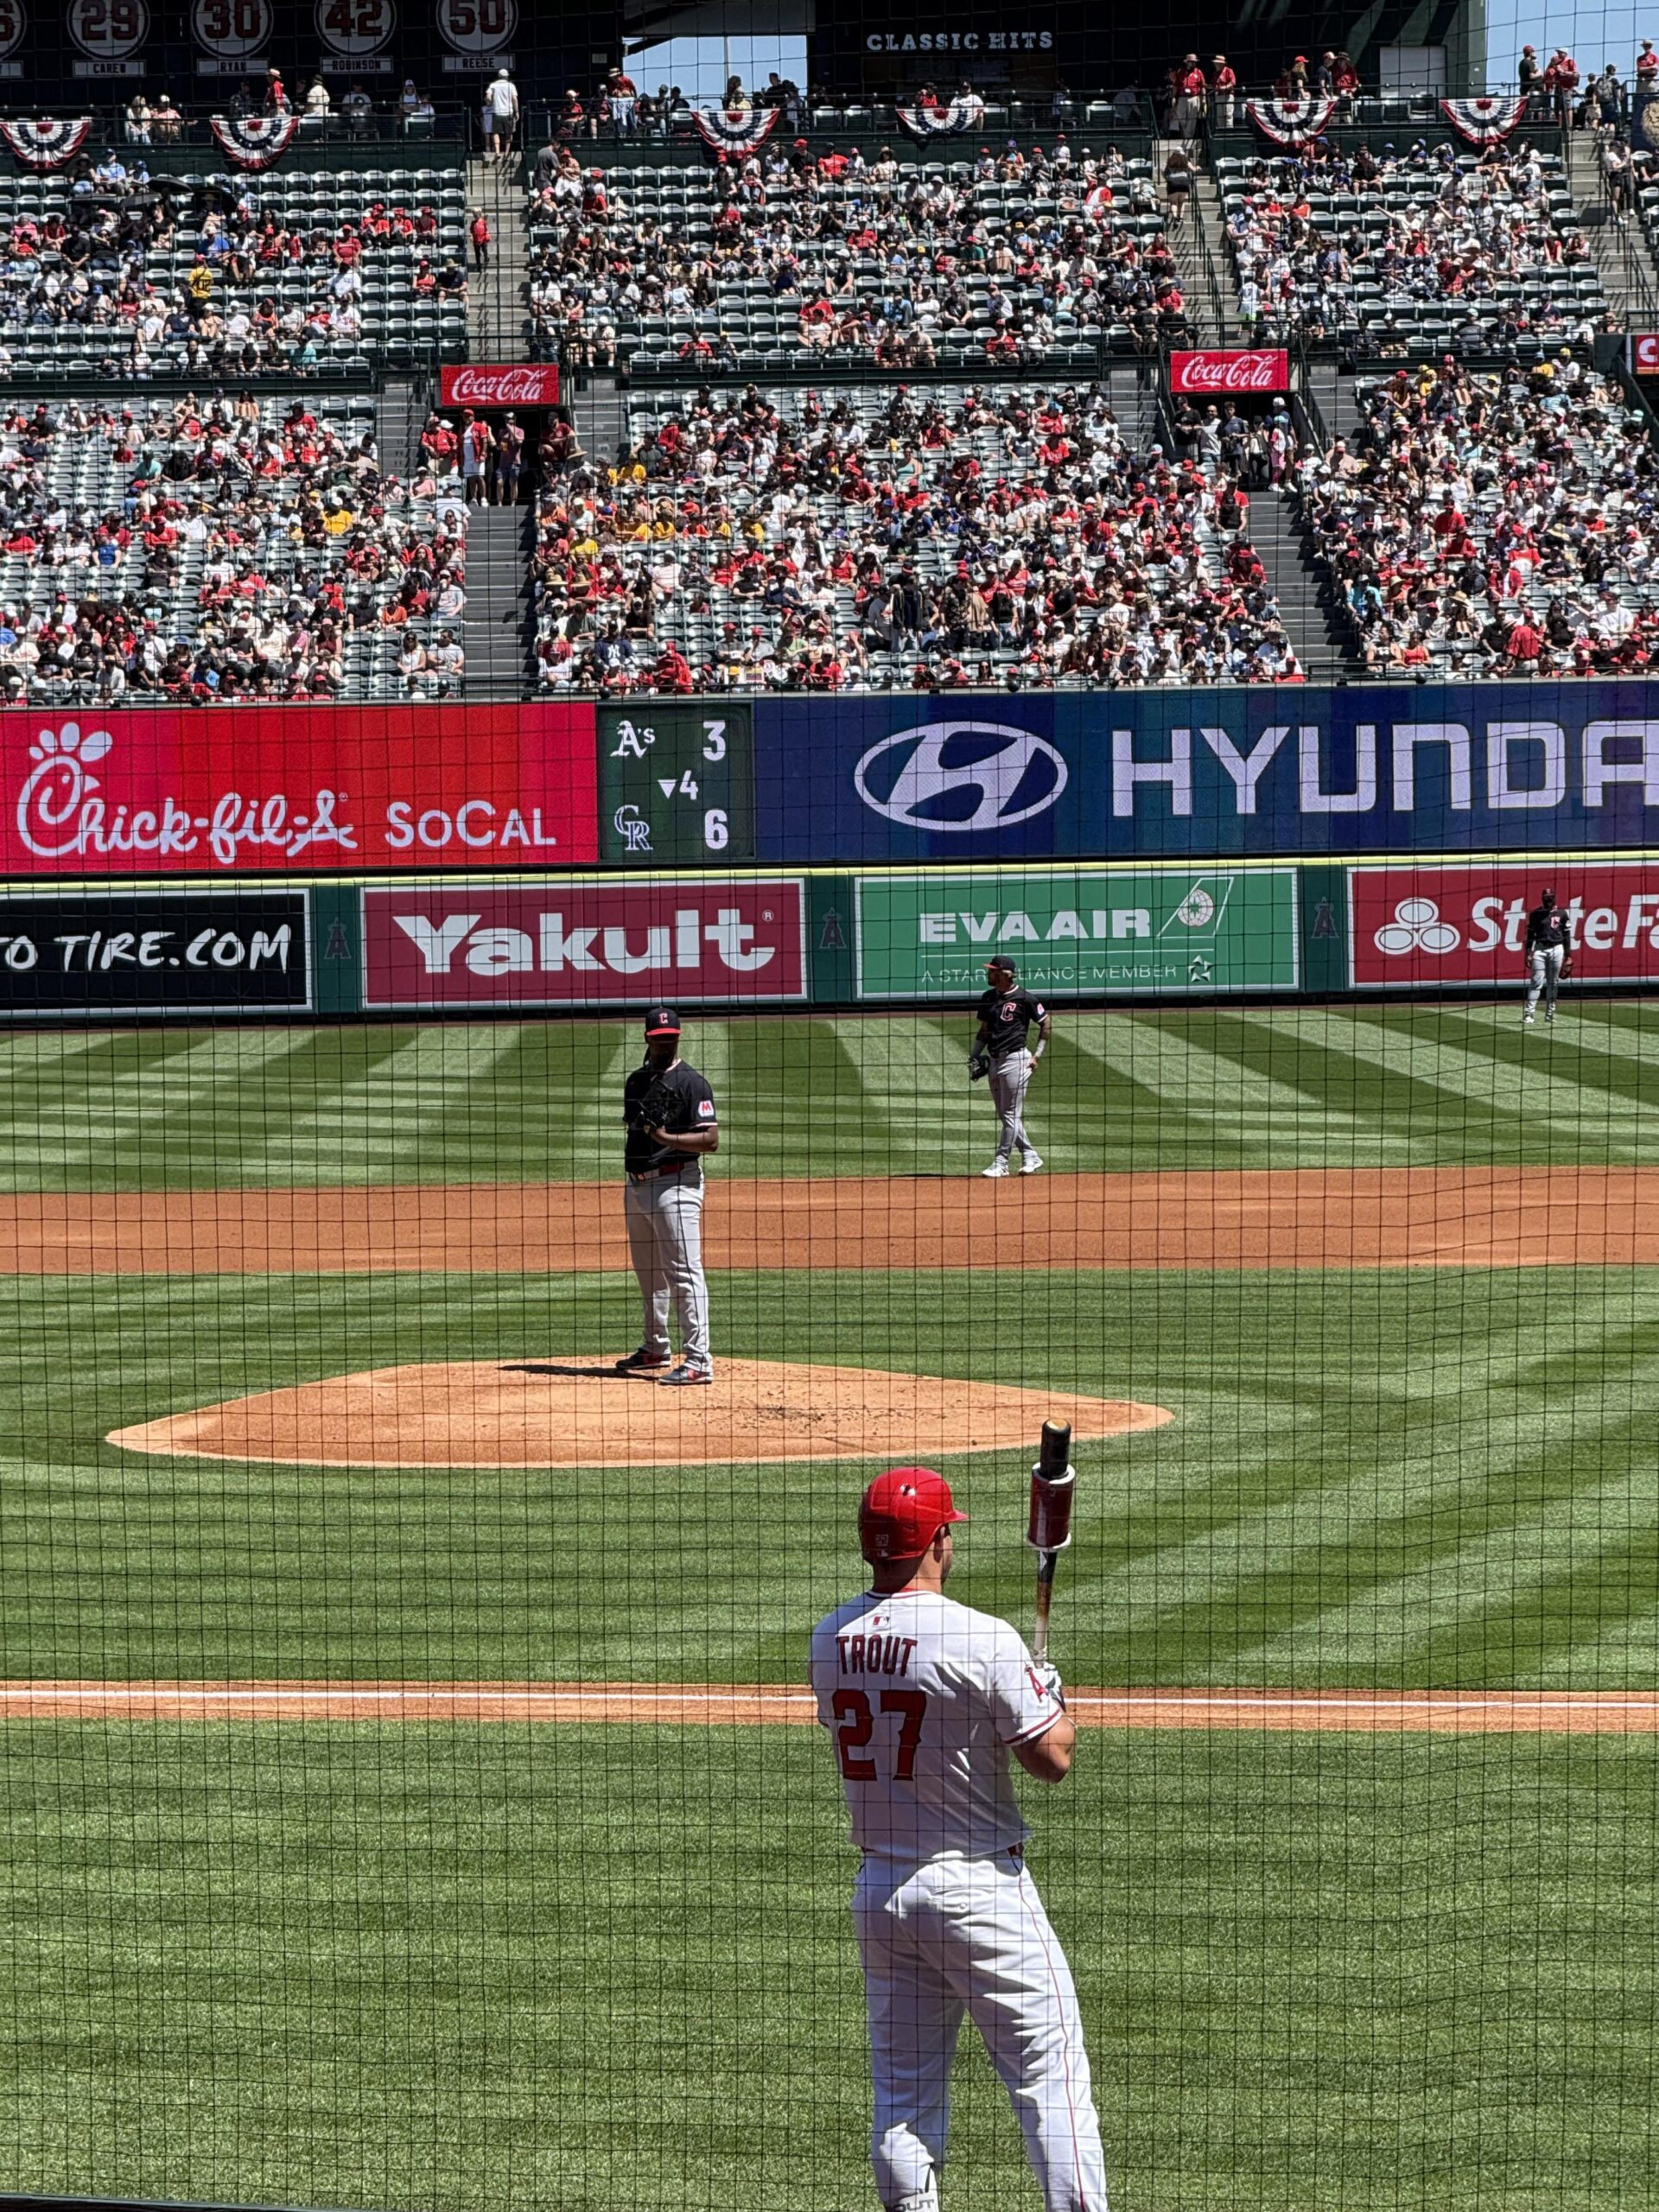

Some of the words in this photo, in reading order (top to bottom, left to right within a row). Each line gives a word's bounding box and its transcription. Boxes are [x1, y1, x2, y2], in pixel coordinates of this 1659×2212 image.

[81, 0, 139, 41] 29
[204, 0, 263, 39] 30
[325, 0, 382, 37] 42
[449, 0, 506, 35] 50
[867, 33, 979, 50] CLASSIC
[988, 31, 1053, 49] HITS
[92, 61, 126, 74] CAREW
[219, 60, 247, 73] RYAN
[332, 60, 381, 71] ROBINSON
[462, 57, 495, 68] REESE
[702, 720, 726, 761] 3
[679, 770, 698, 800] 4
[704, 809, 728, 849] 6
[392, 908, 775, 976] Yakult
[1466, 895, 1618, 951] Stte
[54, 924, 291, 975] TIRE.COM
[921, 970, 933, 982] A
[940, 969, 987, 982] STAR
[1093, 964, 1176, 979] MEMBER
[836, 1635, 918, 1676] TROUT
[832, 1688, 927, 1782] 27
